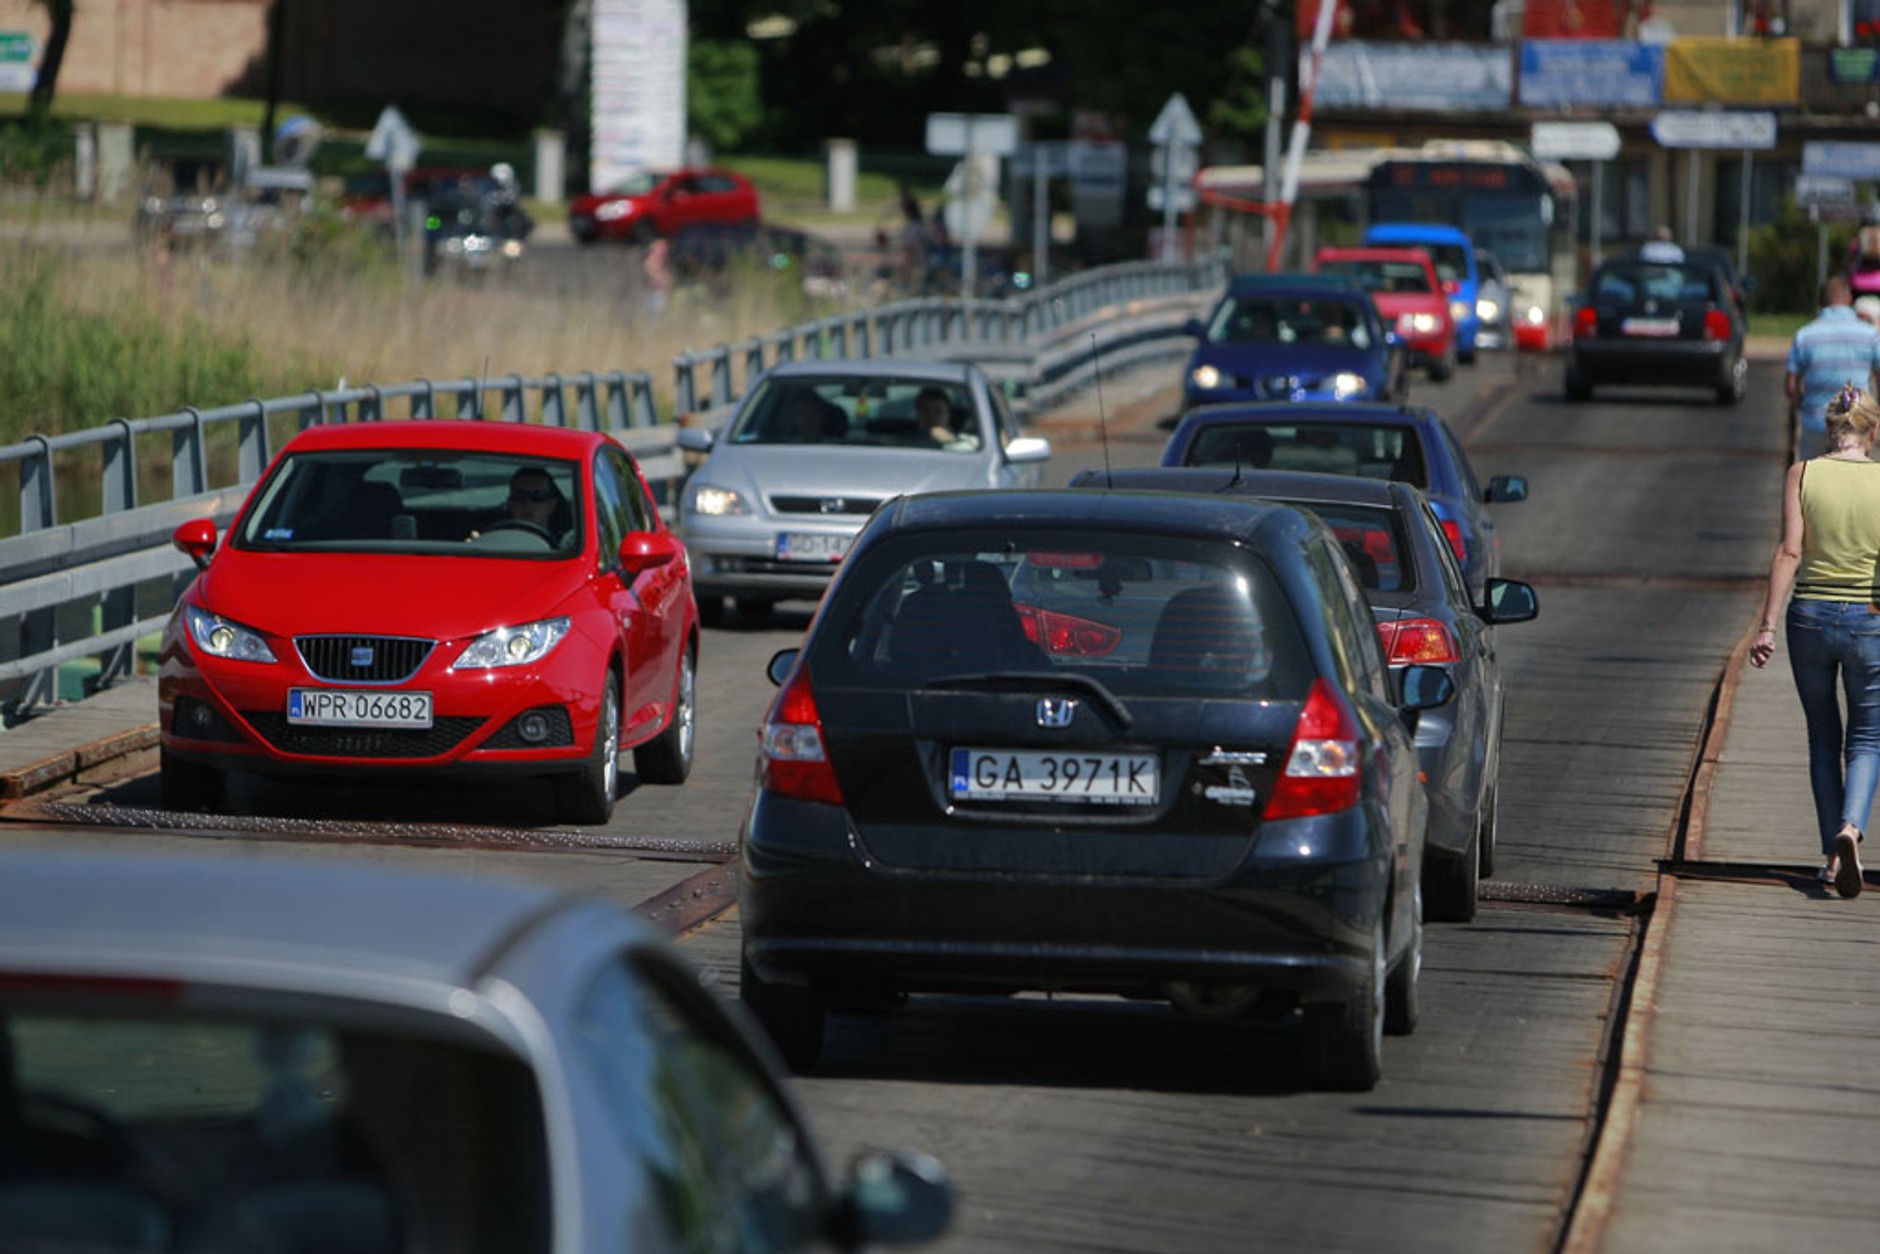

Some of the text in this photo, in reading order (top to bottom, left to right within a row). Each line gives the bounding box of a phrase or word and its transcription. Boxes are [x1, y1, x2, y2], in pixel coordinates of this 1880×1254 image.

[303, 693, 427, 720] WPR 06682
[975, 755, 1148, 794] GA 3971K
